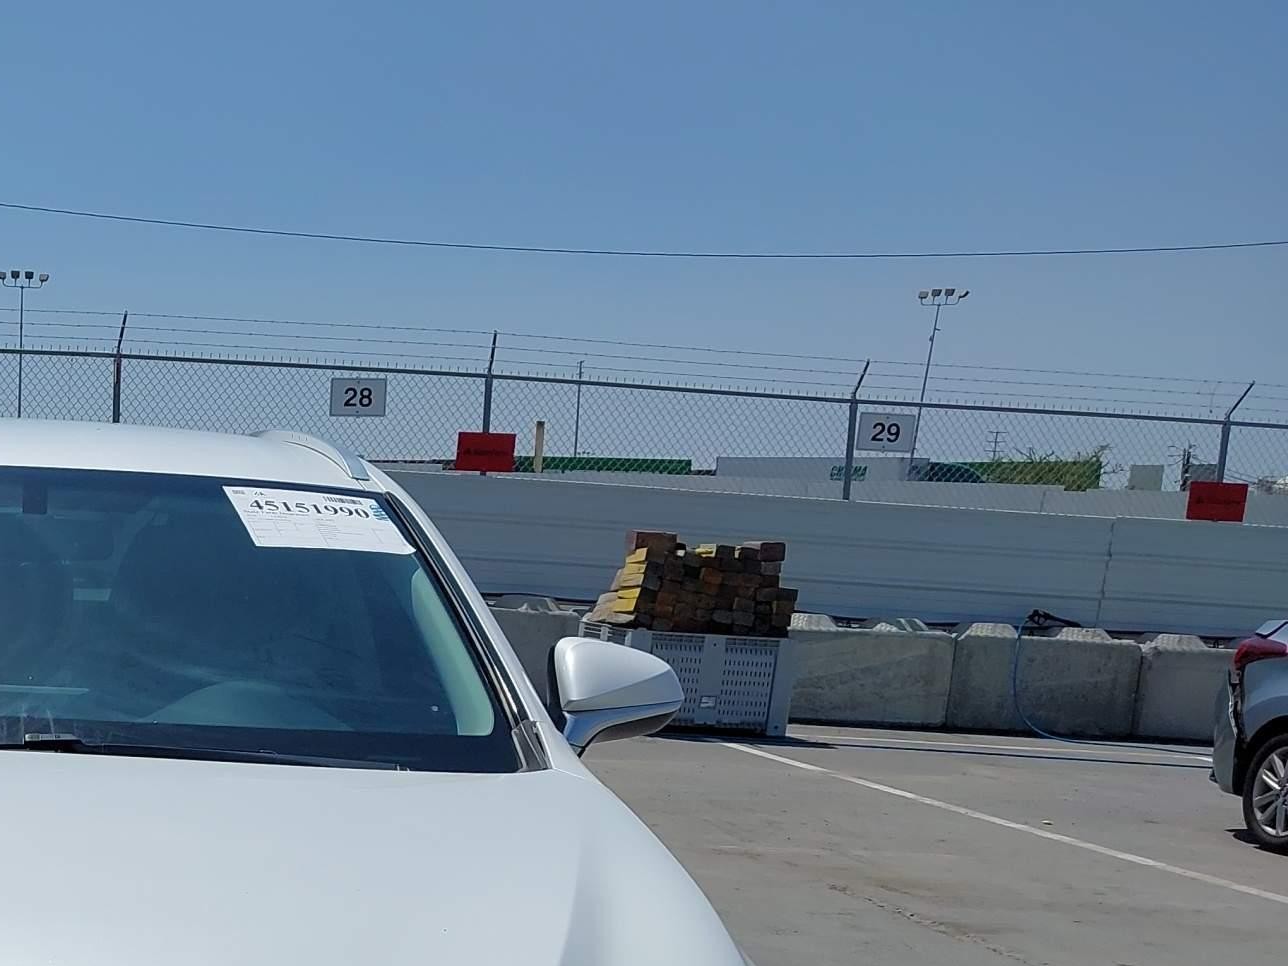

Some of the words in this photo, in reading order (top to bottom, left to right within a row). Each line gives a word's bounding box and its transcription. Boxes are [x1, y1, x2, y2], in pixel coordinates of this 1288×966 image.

[343, 387, 373, 407] 28
[870, 422, 901, 443] 29
[248, 498, 371, 519] 45151990
